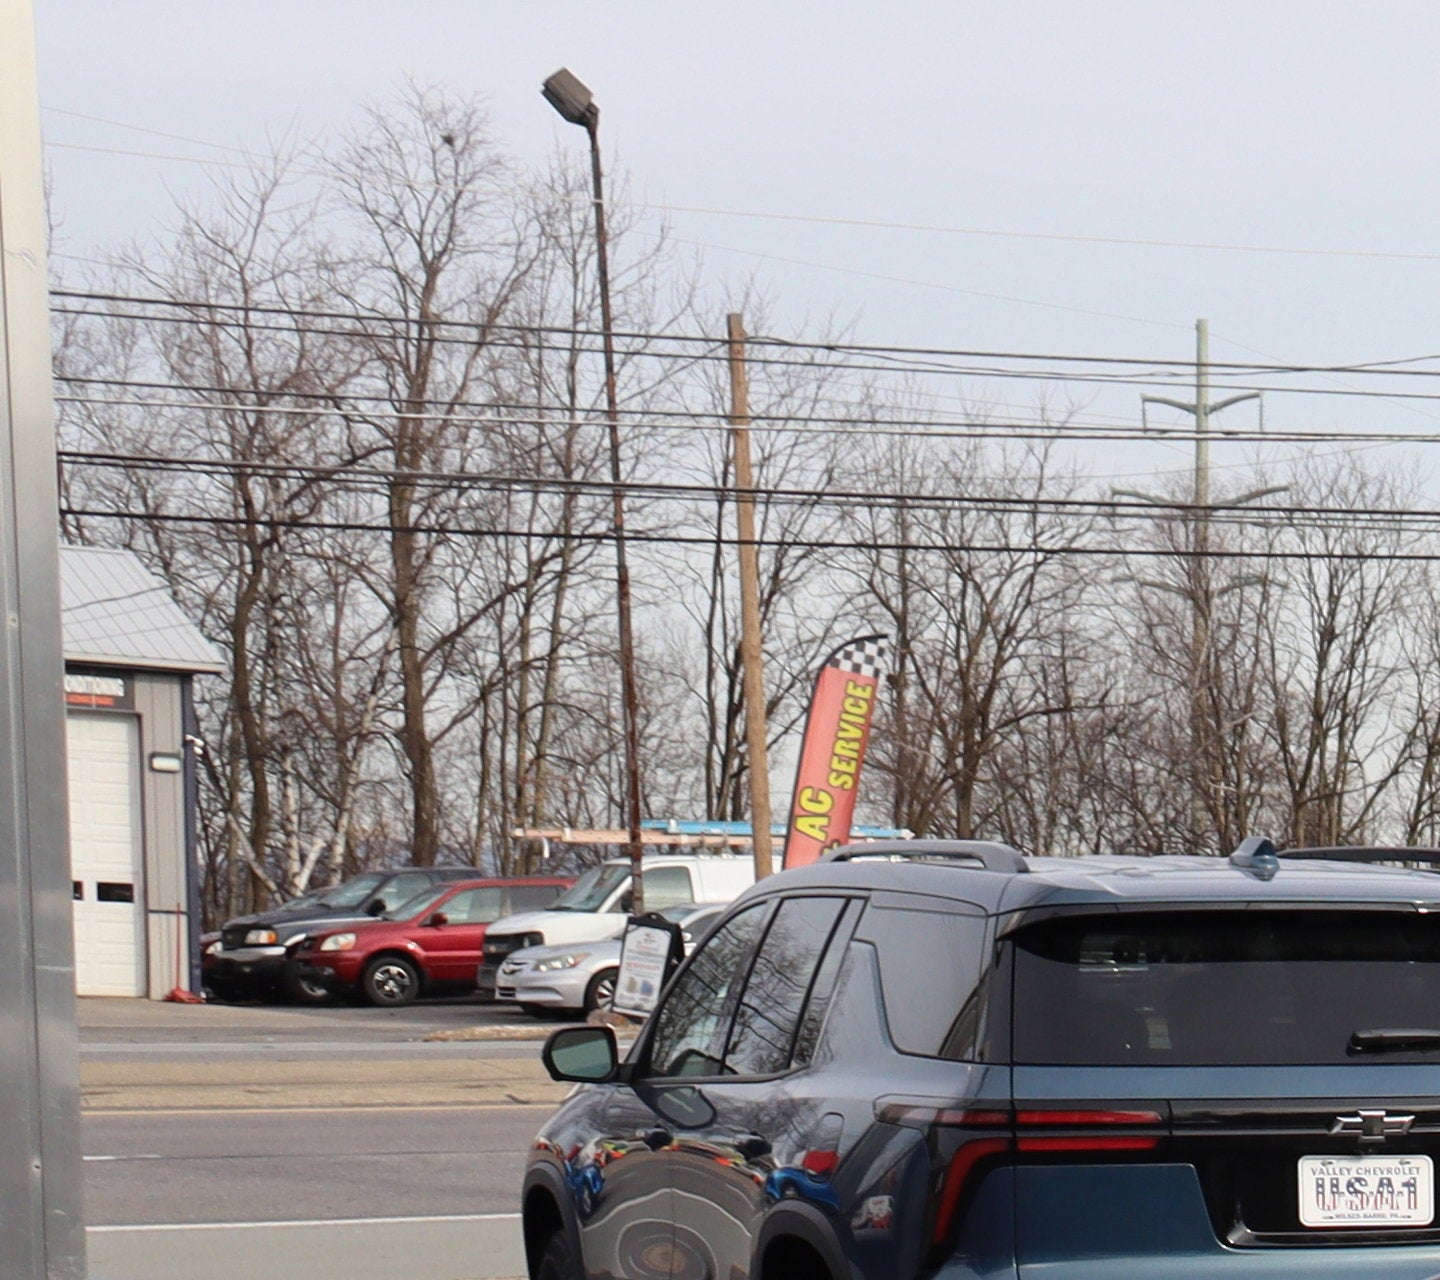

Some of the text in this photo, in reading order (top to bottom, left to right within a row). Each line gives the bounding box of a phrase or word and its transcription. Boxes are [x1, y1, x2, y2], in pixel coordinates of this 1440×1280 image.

[829, 680, 873, 790] SERVICE
[794, 786, 834, 842] AC
[1311, 1166, 1421, 1176] VALLEY CHEVROLET
